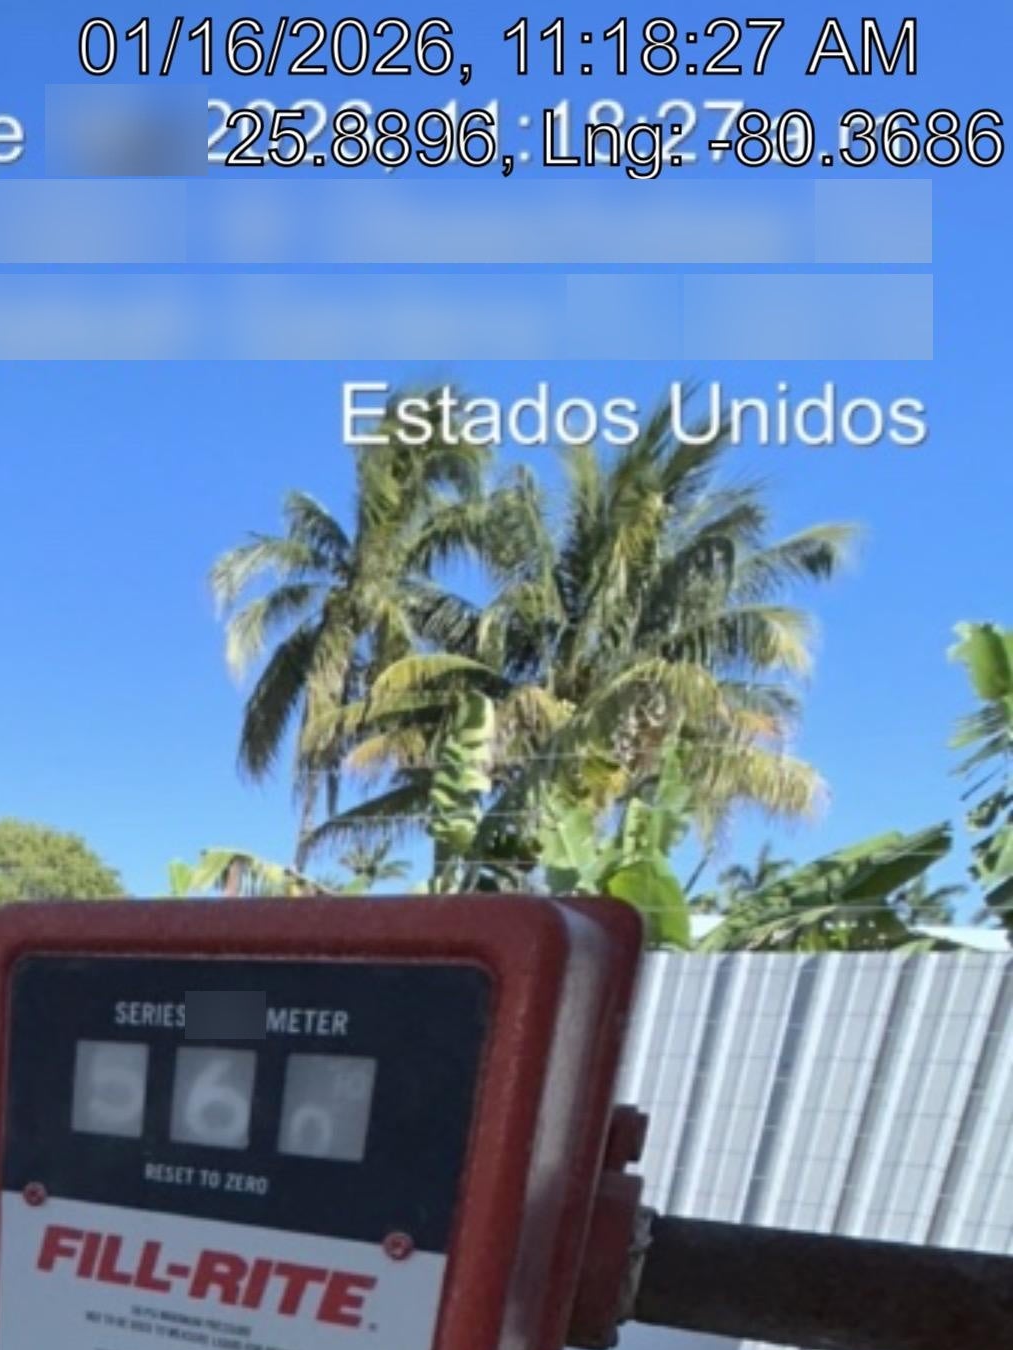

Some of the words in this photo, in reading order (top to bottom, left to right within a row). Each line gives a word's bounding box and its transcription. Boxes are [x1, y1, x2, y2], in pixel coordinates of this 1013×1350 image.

[114, 1000, 185, 1028] SERIES
[265, 1007, 349, 1036] METER
[199, 1168, 222, 1190] TO
[36, 1223, 378, 1328] FILL-RITE
